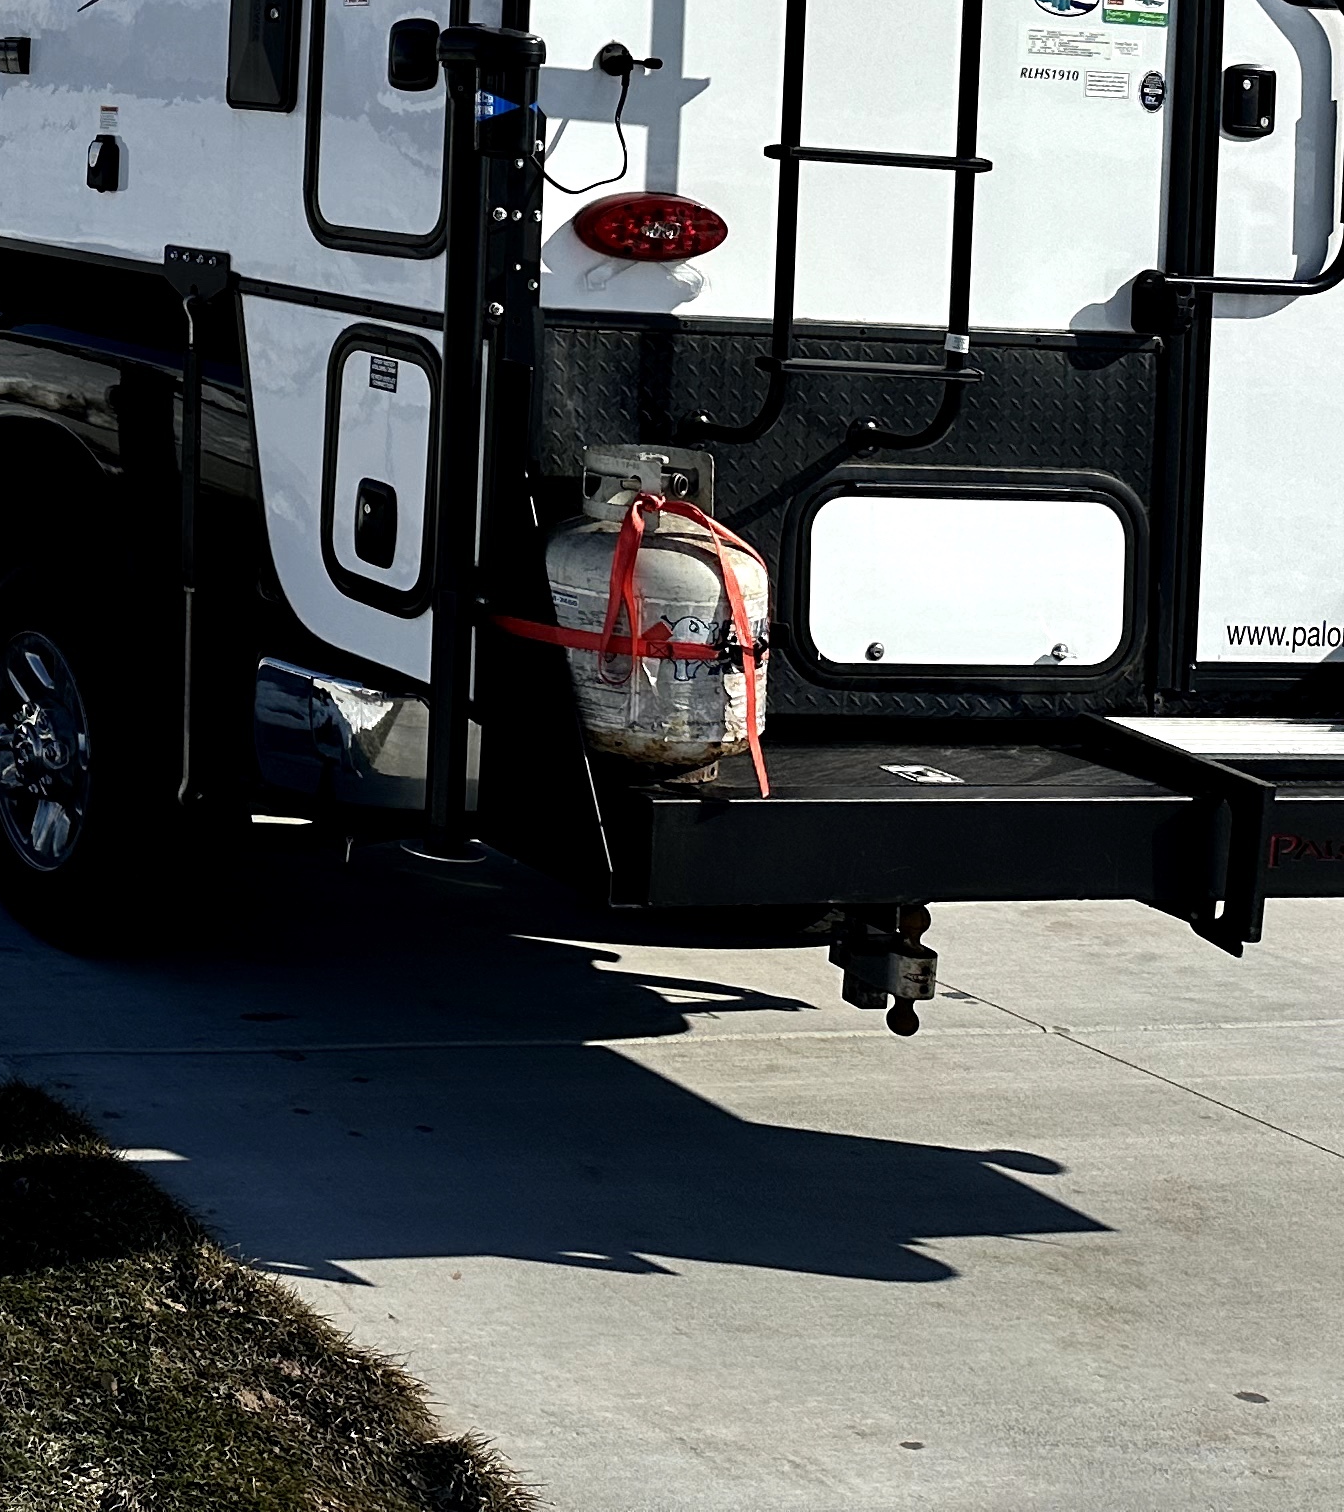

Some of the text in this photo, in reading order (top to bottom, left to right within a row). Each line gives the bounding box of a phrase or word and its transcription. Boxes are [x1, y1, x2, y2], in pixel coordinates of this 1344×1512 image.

[1019, 67, 1080, 82] RLHS1910
[1226, 619, 1344, 654] www.palo
[1268, 833, 1344, 868] PAL
